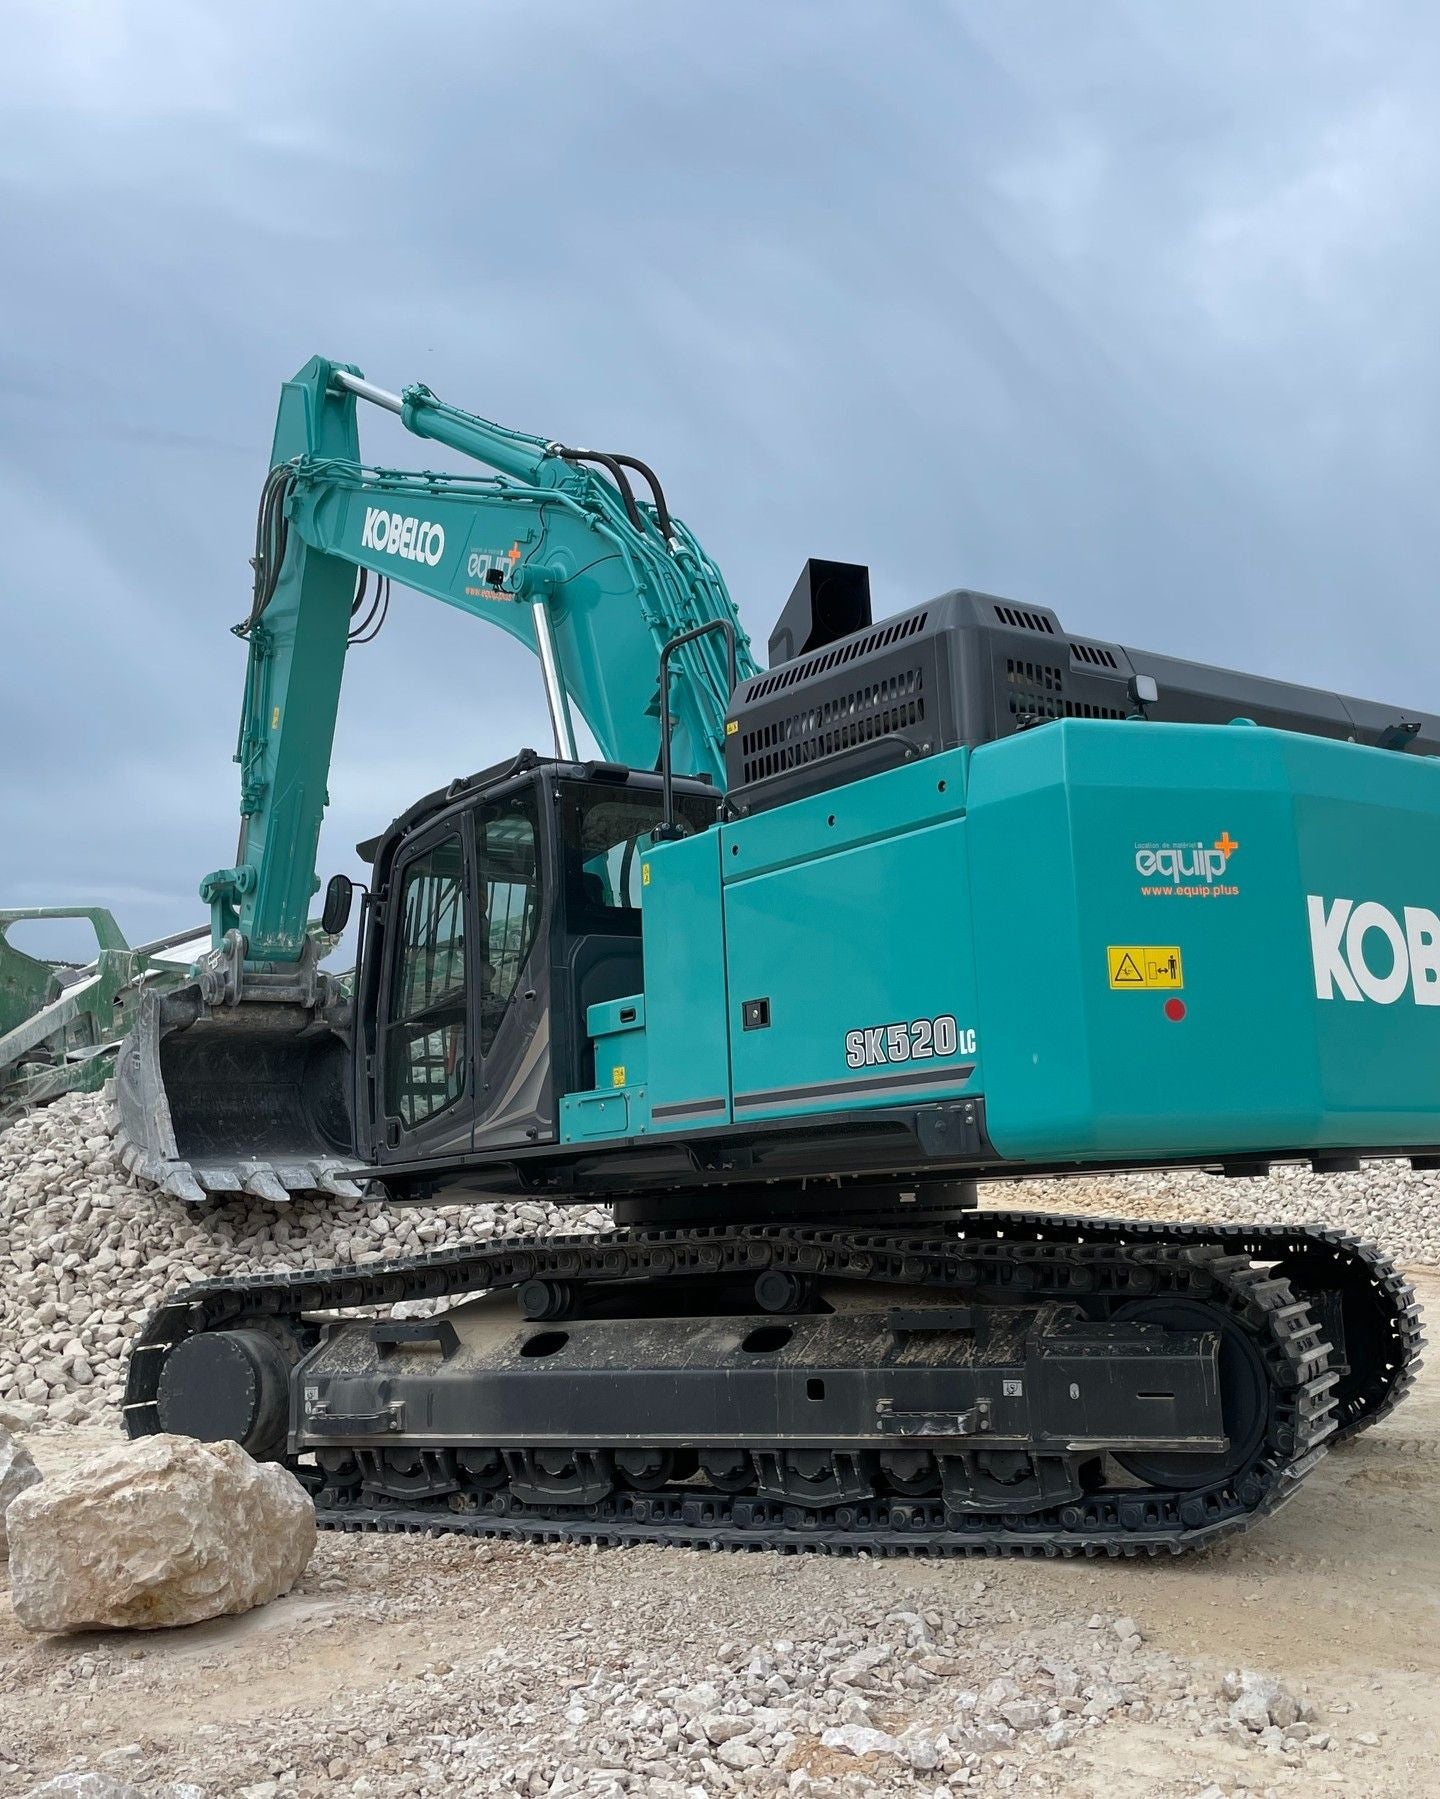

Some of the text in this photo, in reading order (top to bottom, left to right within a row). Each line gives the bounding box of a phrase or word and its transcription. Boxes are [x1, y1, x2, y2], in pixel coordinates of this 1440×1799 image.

[361, 506, 445, 567] KOBELCO
[1141, 885, 1240, 897] www.equip.plus
[1306, 894, 1440, 1006] KOB
[846, 1014, 977, 1069] SK520 LC
